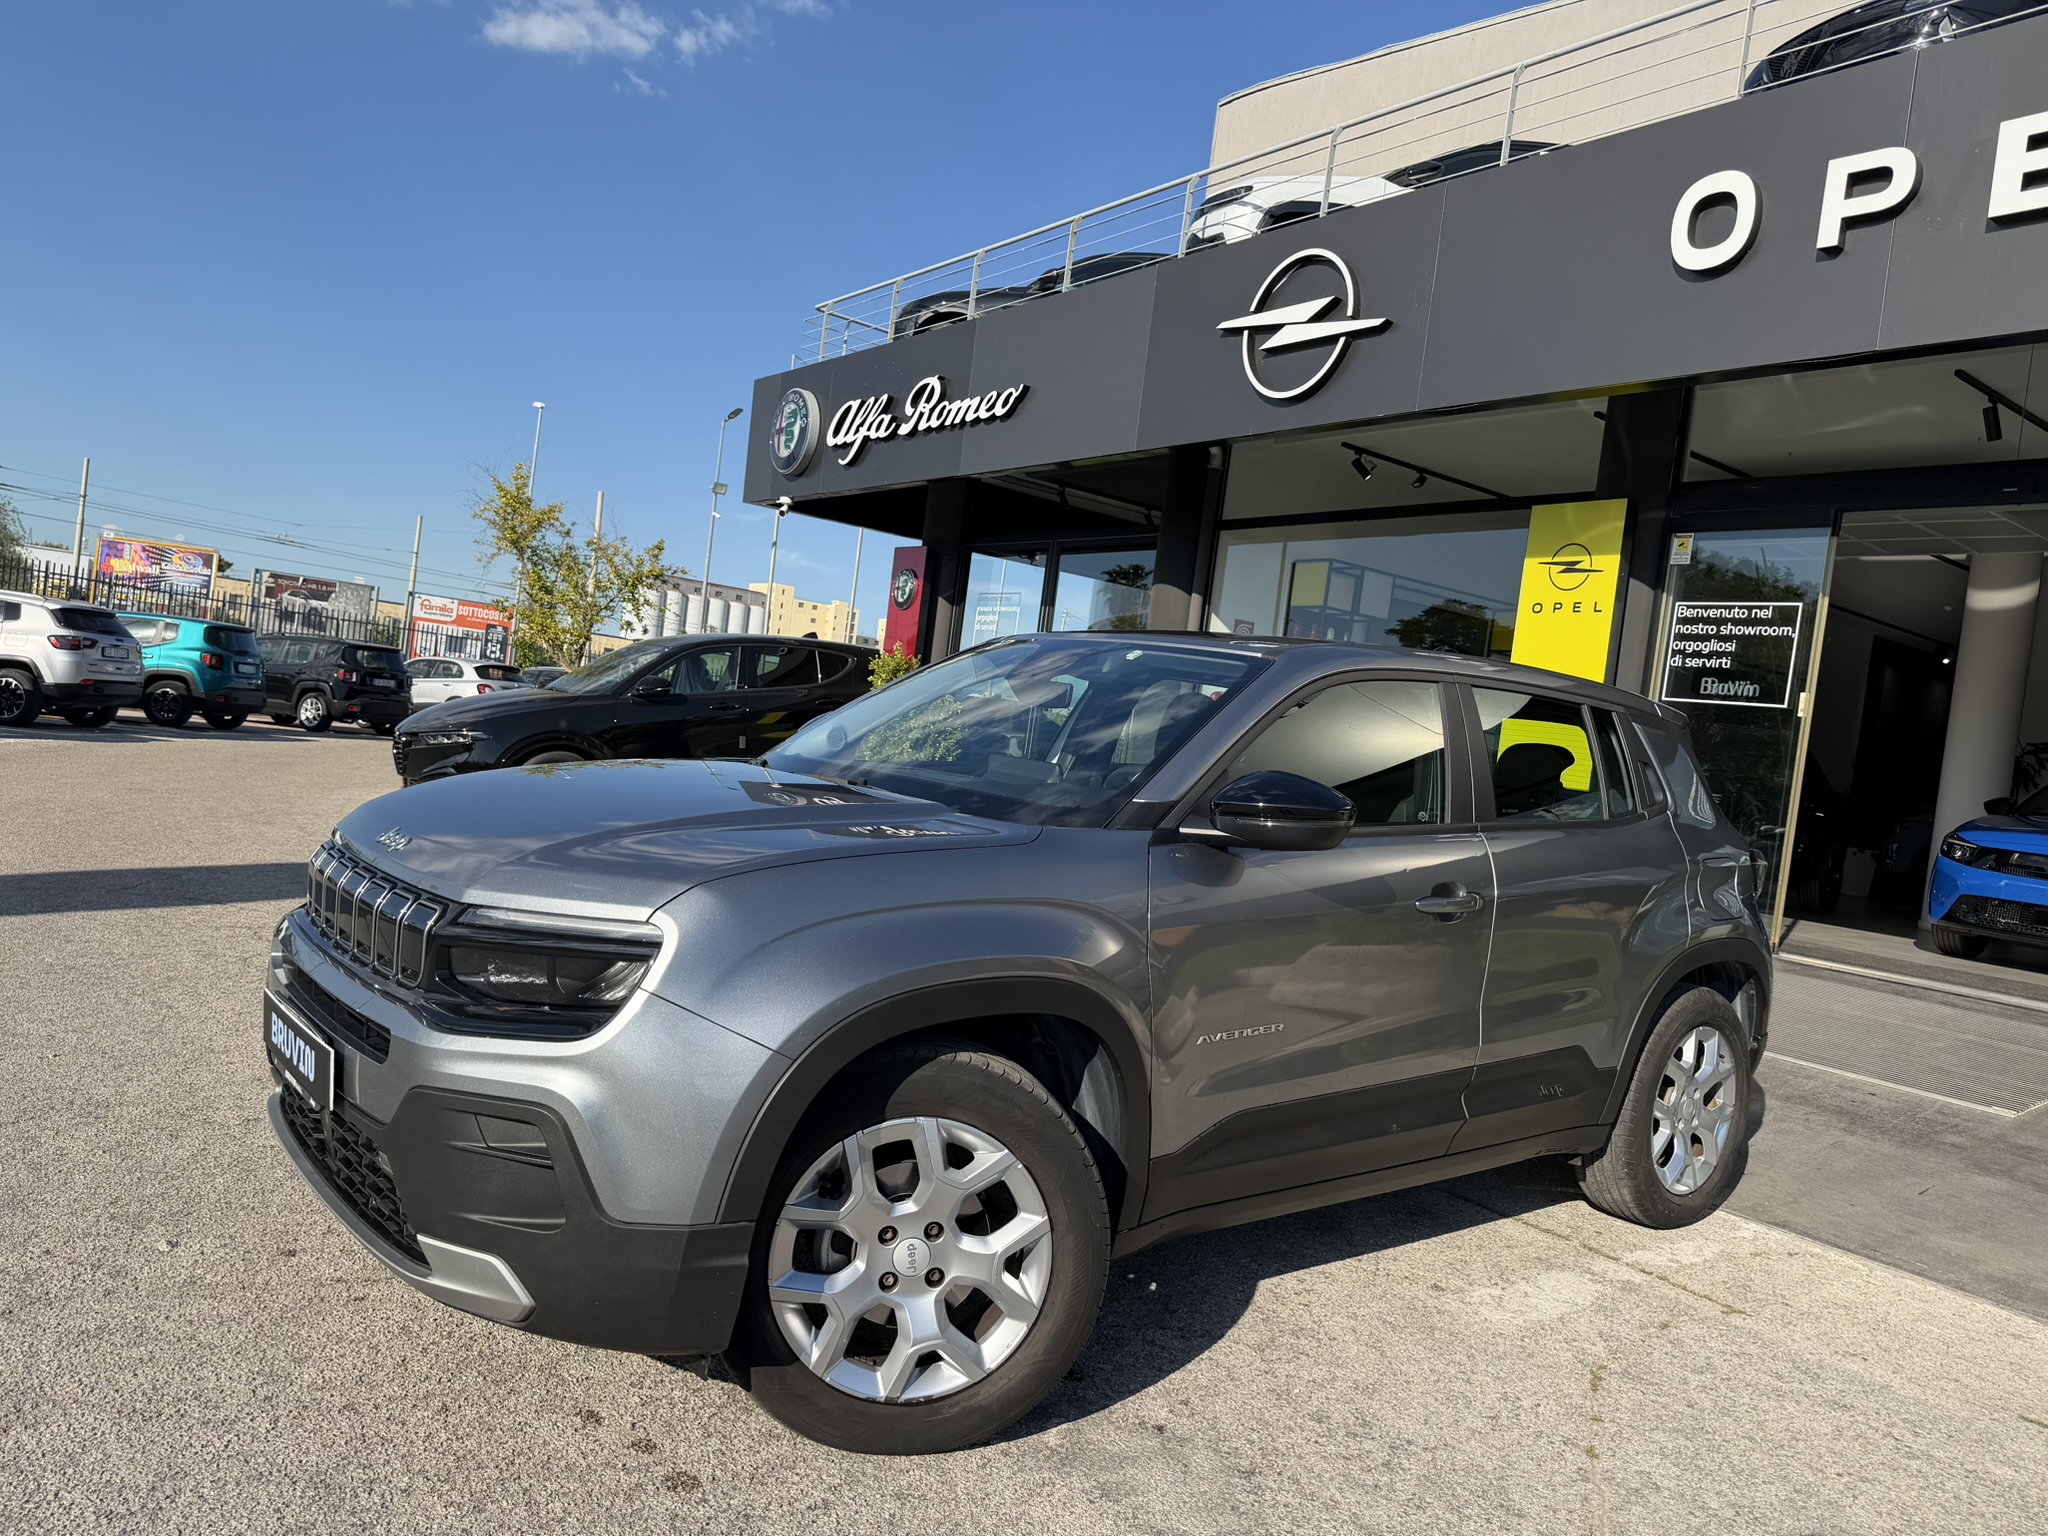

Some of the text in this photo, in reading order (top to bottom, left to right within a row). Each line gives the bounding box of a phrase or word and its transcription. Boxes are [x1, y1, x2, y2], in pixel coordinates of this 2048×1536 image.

[826, 393, 896, 466] Alfa
[898, 374, 1024, 436] Romeo
[419, 598, 454, 614] famila
[1531, 601, 1603, 614] OPEL
[1677, 605, 1773, 619] Benvenuto nel
[1674, 622, 1796, 638] nostro showroom,
[1672, 639, 1736, 654] orgogliosi
[1670, 655, 1731, 669] di servirti
[1196, 1023, 1284, 1045] AVENGER
[271, 1011, 315, 1082] BRUVIN
[905, 1242, 917, 1273] Jeep
